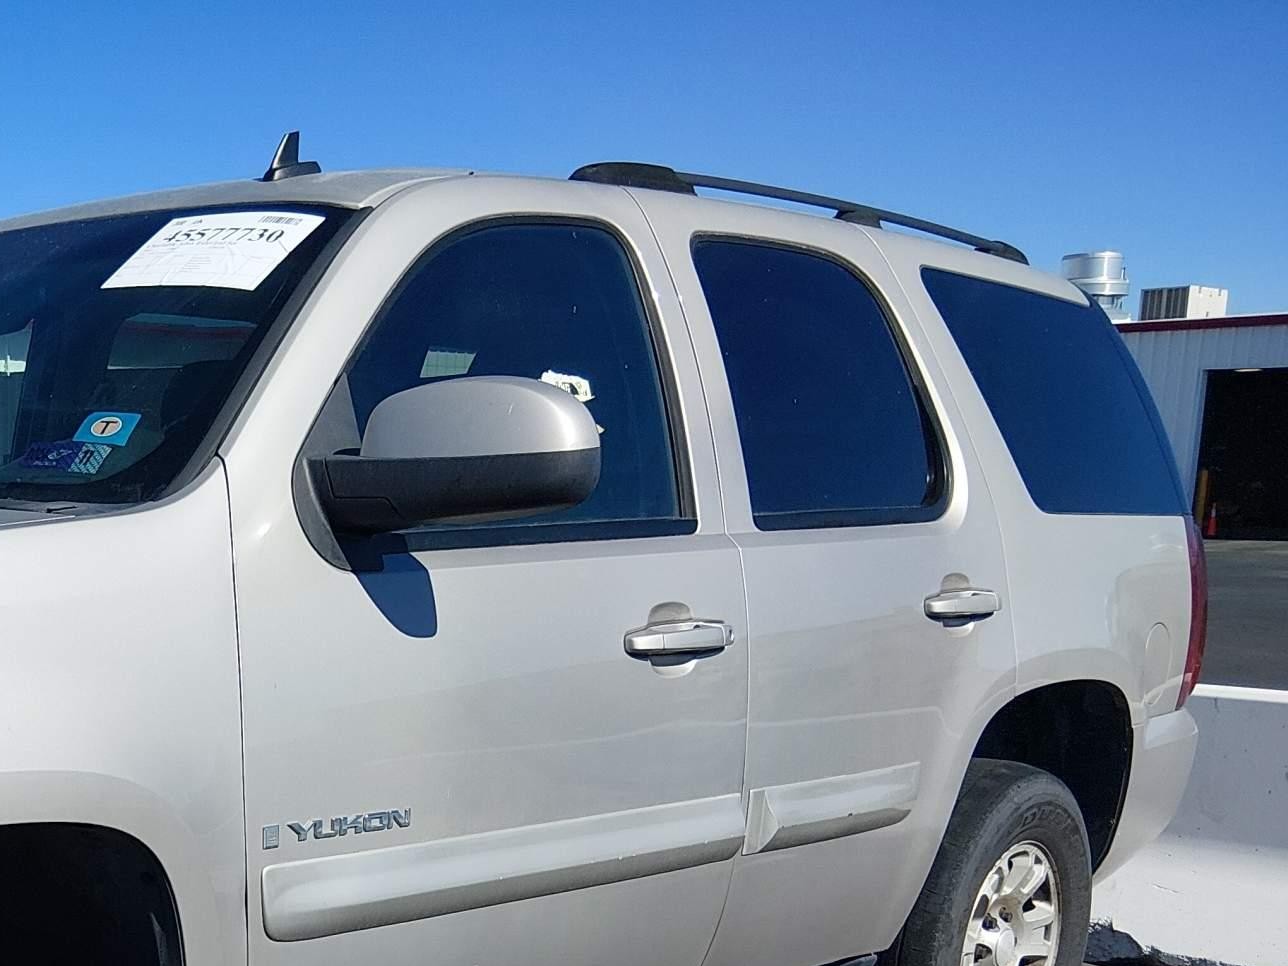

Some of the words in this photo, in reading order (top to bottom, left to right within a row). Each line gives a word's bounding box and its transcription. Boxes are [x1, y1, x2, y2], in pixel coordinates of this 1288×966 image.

[163, 227, 285, 243] 45577730
[99, 420, 119, 435] T
[287, 807, 411, 842] YUKON
